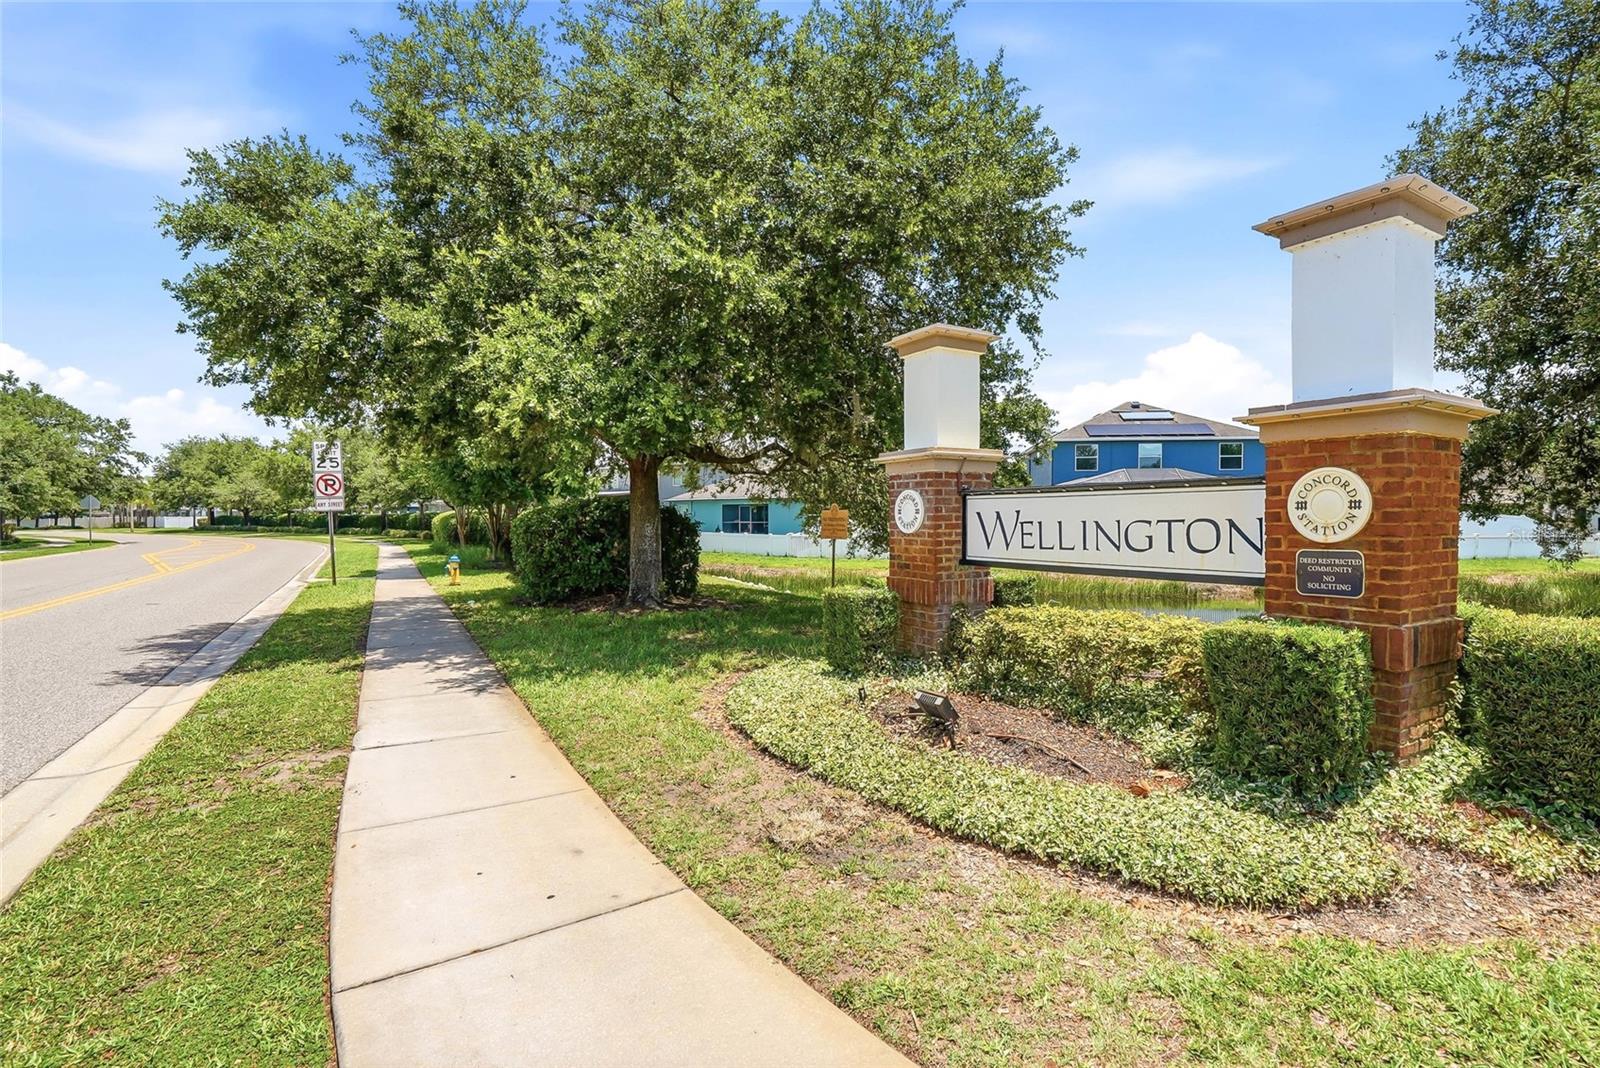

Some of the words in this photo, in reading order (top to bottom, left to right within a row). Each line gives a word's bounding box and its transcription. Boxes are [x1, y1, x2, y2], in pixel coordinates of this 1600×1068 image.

[316, 457, 340, 468] 25
[1297, 474, 1358, 499] CONCORD
[897, 493, 918, 508] CONCORD
[898, 515, 918, 530] STATION
[1297, 512, 1358, 535] STATION
[975, 509, 1264, 556] WELLINGTON
[1307, 565, 1353, 573] COMMUNITY
[1318, 558, 1362, 566] RESTRICTED
[1307, 582, 1352, 591] SOLICITING
